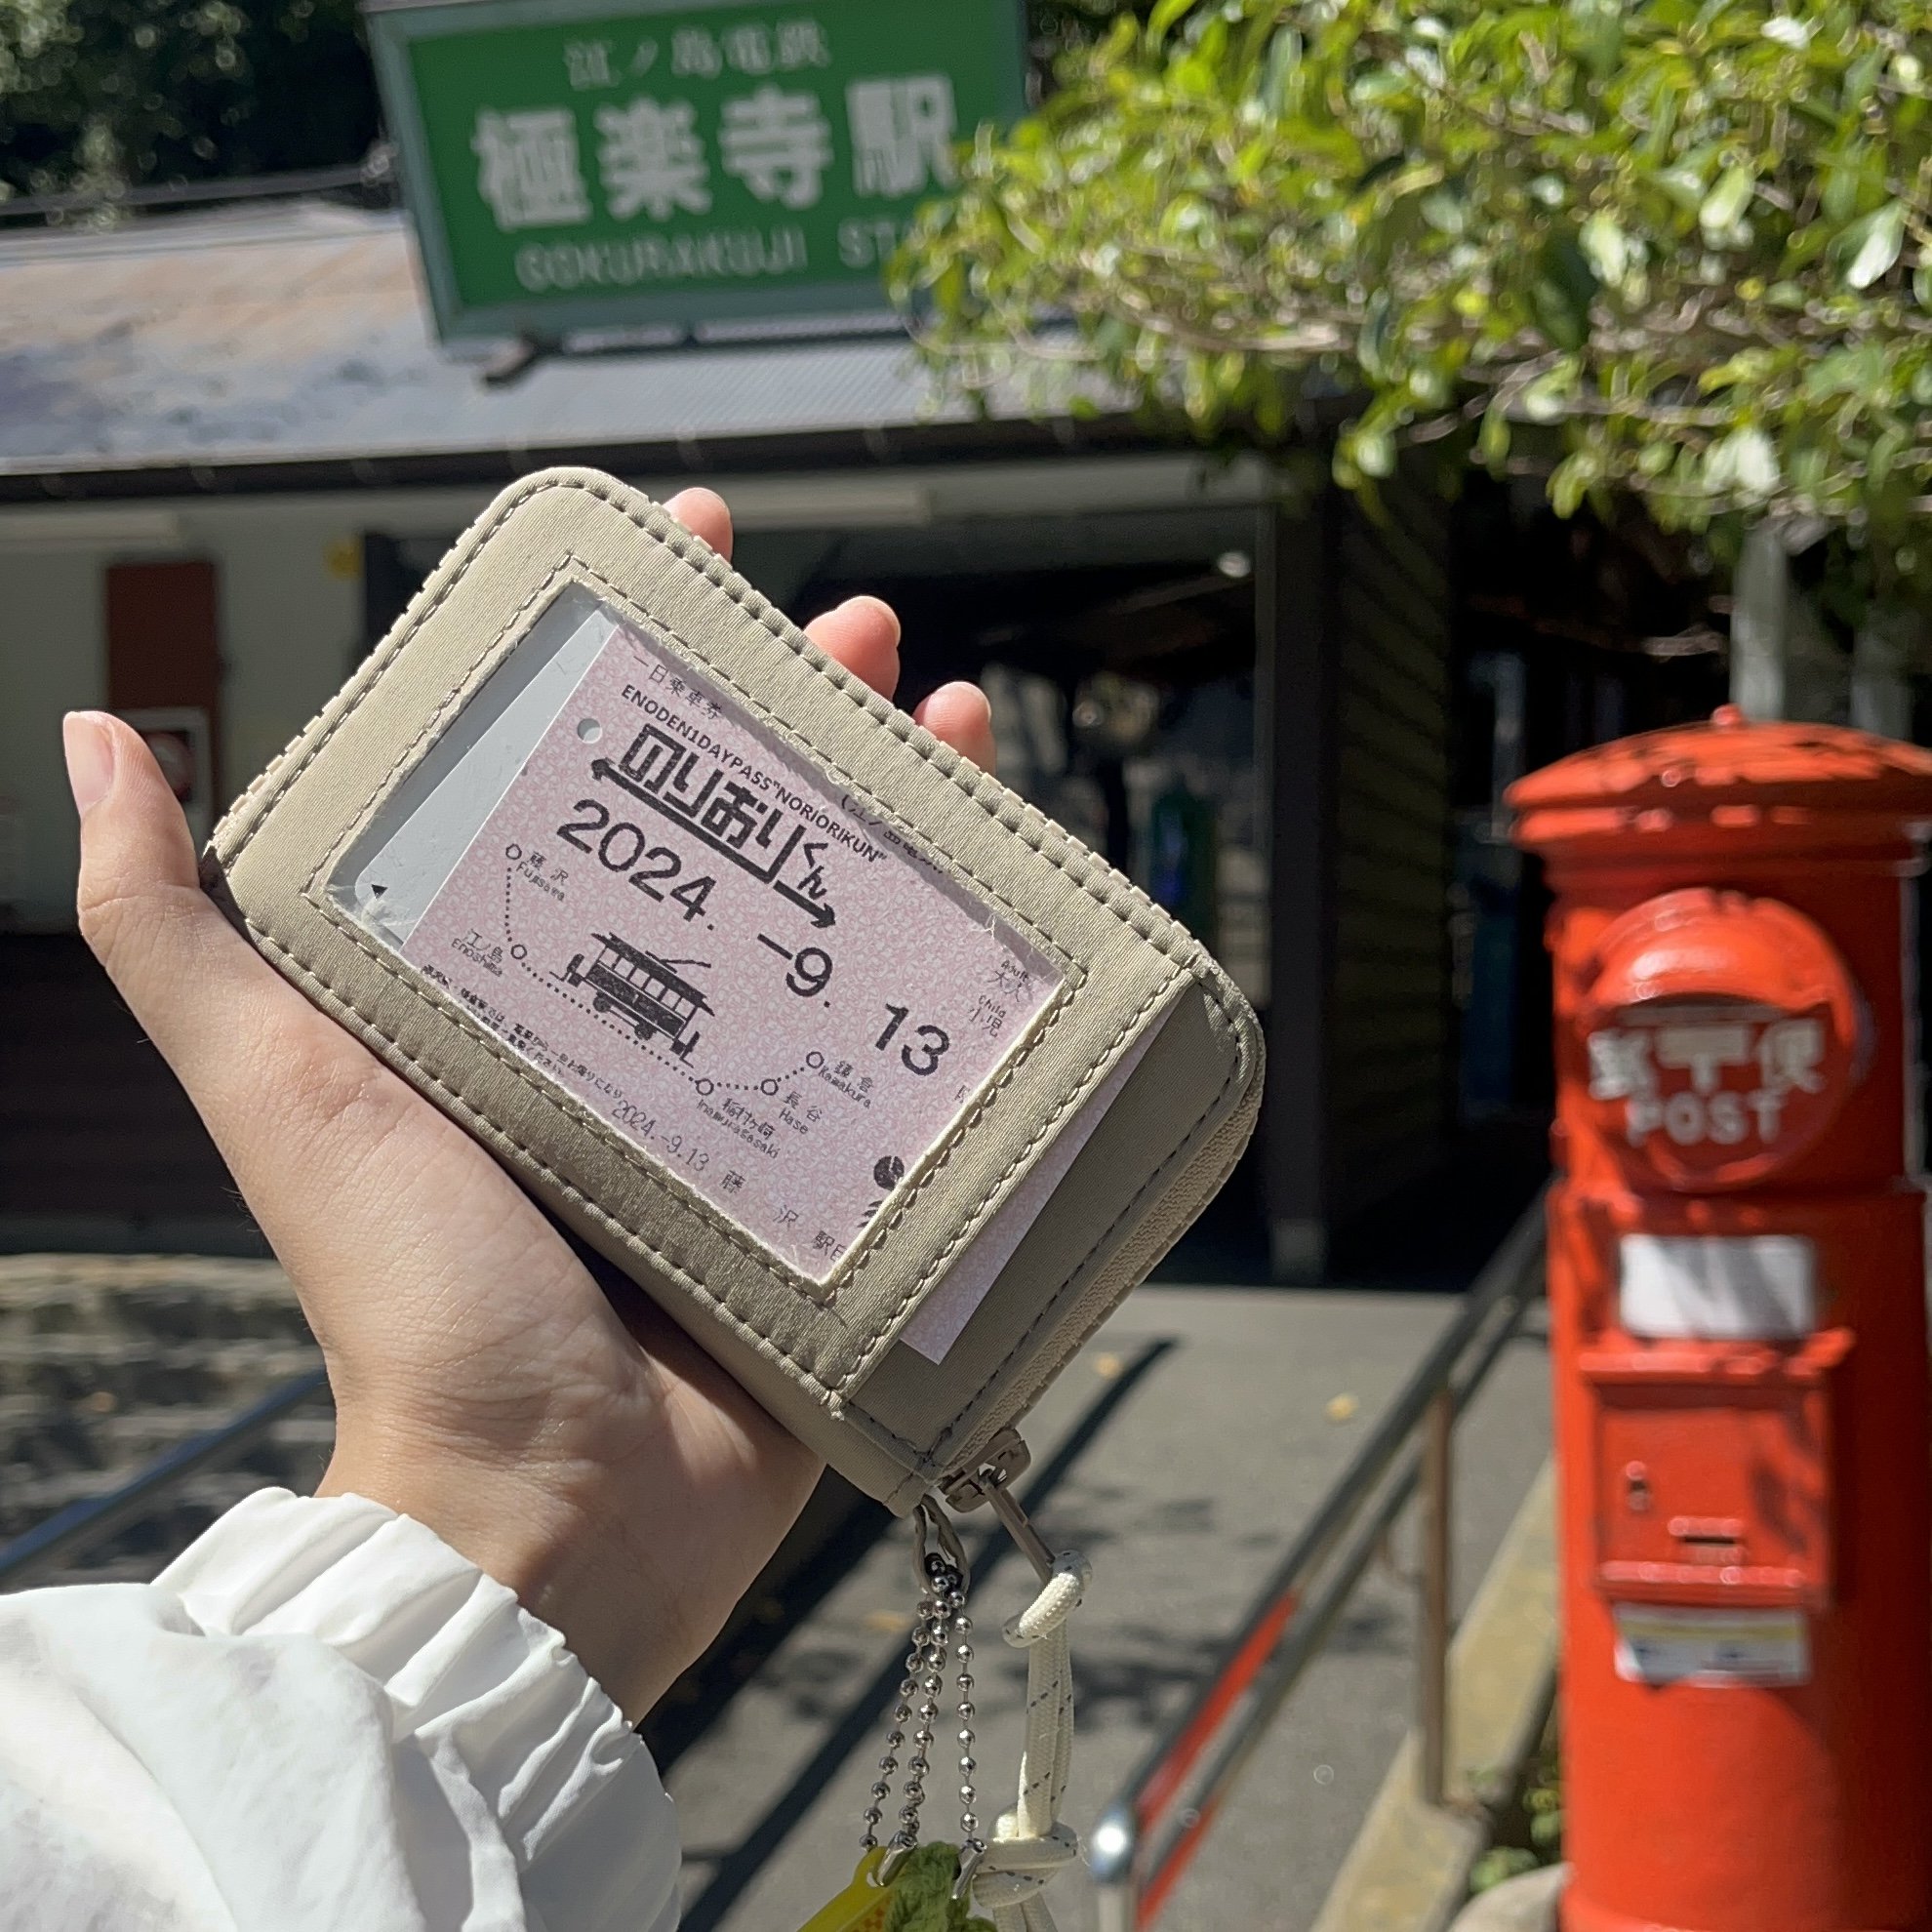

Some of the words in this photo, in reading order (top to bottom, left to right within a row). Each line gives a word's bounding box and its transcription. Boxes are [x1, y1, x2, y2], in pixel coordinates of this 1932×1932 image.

[472, 74, 961, 234] 極楽寺駅
[513, 224, 808, 293] GOKURAKUJI
[619, 723, 829, 904] のりおりくん
[978, 994, 1007, 1020] Child
[874, 1002, 951, 1077] 13
[817, 1065, 871, 1109] Kamakura
[1626, 1089, 1785, 1146] POST
[778, 1107, 809, 1135] Hase
